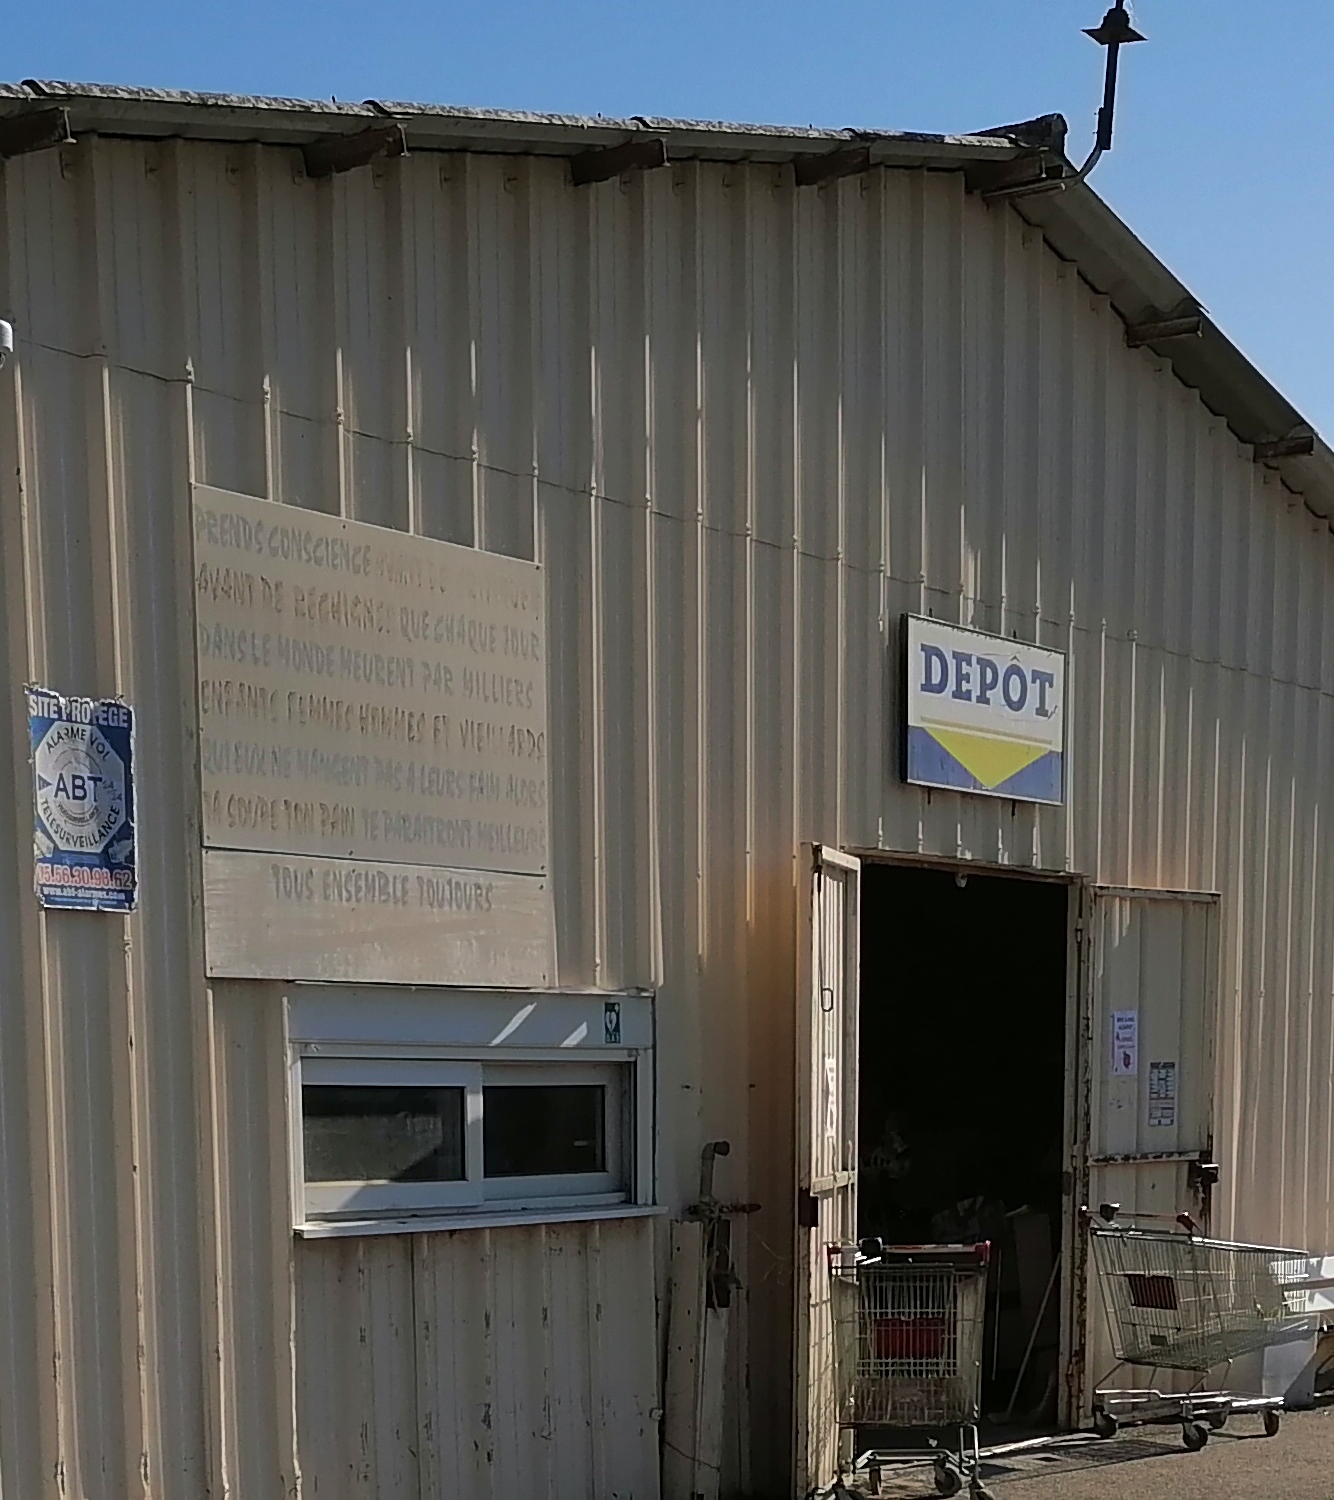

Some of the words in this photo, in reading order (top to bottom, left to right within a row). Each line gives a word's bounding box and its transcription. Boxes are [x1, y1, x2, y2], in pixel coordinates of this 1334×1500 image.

[195, 504, 263, 554] PRENDS
[267, 524, 371, 576] CONSCIENCE
[197, 562, 254, 608] AVANT
[260, 575, 283, 614] DE
[399, 606, 429, 642] QUE
[433, 612, 496, 654] CHAQUE
[502, 624, 540, 662] JOUR
[199, 622, 247, 663] DANS
[250, 630, 271, 667] LE
[277, 632, 334, 678] MONDE
[339, 645, 414, 689] MEURENT
[421, 660, 454, 697] PAR
[462, 666, 534, 709] MILLIERS
[920, 642, 1054, 718] DEPÔT
[29, 694, 58, 719] SITE
[433, 714, 451, 749] ET
[45, 726, 87, 754] ALARME
[89, 732, 111, 761] VOL
[53, 771, 103, 802] ABT
[269, 862, 314, 900] TOUS
[322, 868, 409, 906] ENSEMBLE
[416, 875, 494, 912] TOUJOURS
